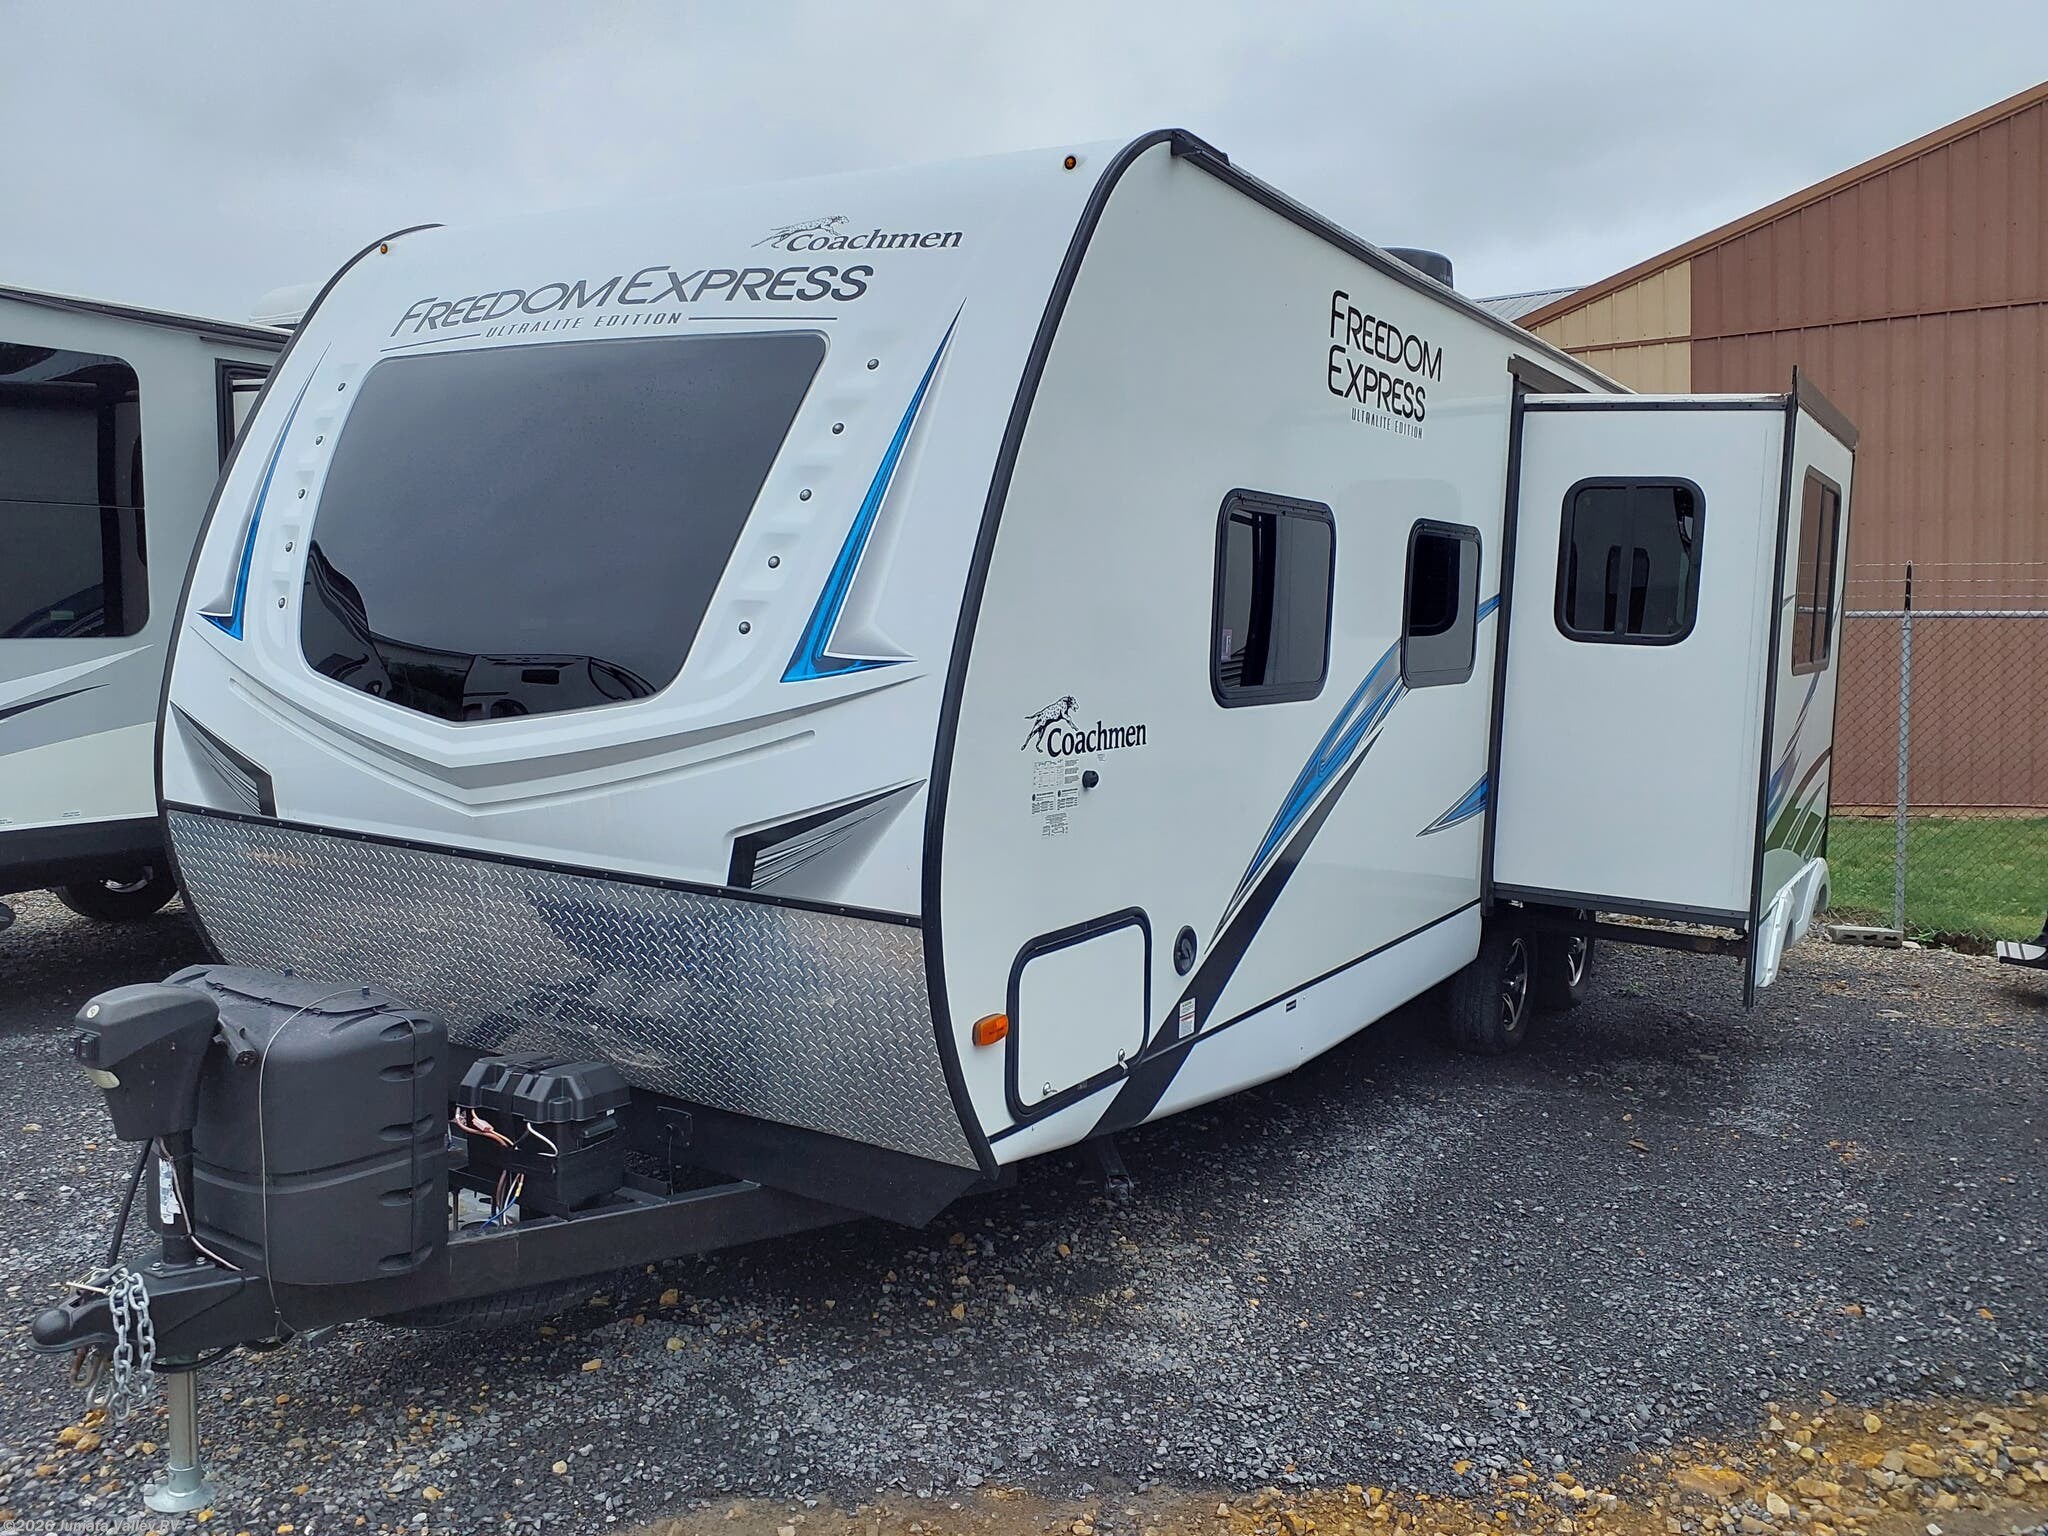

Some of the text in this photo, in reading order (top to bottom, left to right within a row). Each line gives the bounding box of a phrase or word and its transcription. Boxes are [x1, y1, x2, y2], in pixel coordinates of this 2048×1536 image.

[786, 228, 963, 252] Coachmen
[486, 312, 682, 338] ULTRALITE EDITION
[1330, 289, 1442, 382] FREEDOM
[1328, 344, 1426, 423] EXPRESS
[1351, 407, 1423, 439] ULTRALITE EDITION
[1047, 720, 1147, 758] Coachmen
